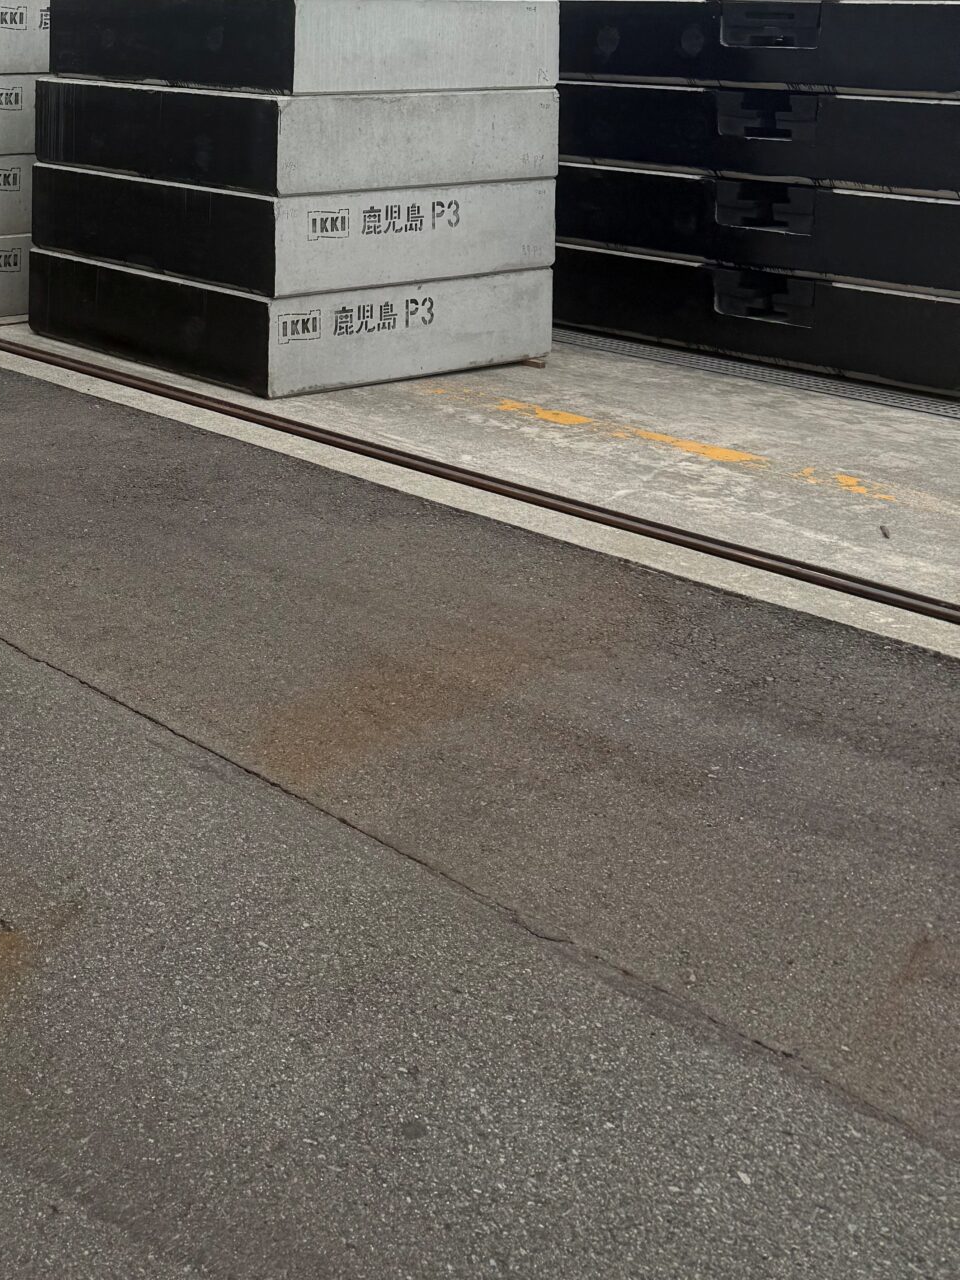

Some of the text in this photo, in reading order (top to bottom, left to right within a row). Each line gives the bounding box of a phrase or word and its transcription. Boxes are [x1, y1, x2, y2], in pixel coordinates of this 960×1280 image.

[311, 199, 460, 235] IKKI 鹿児島 P3
[282, 296, 435, 337] IKKI 鹿児島 P3
